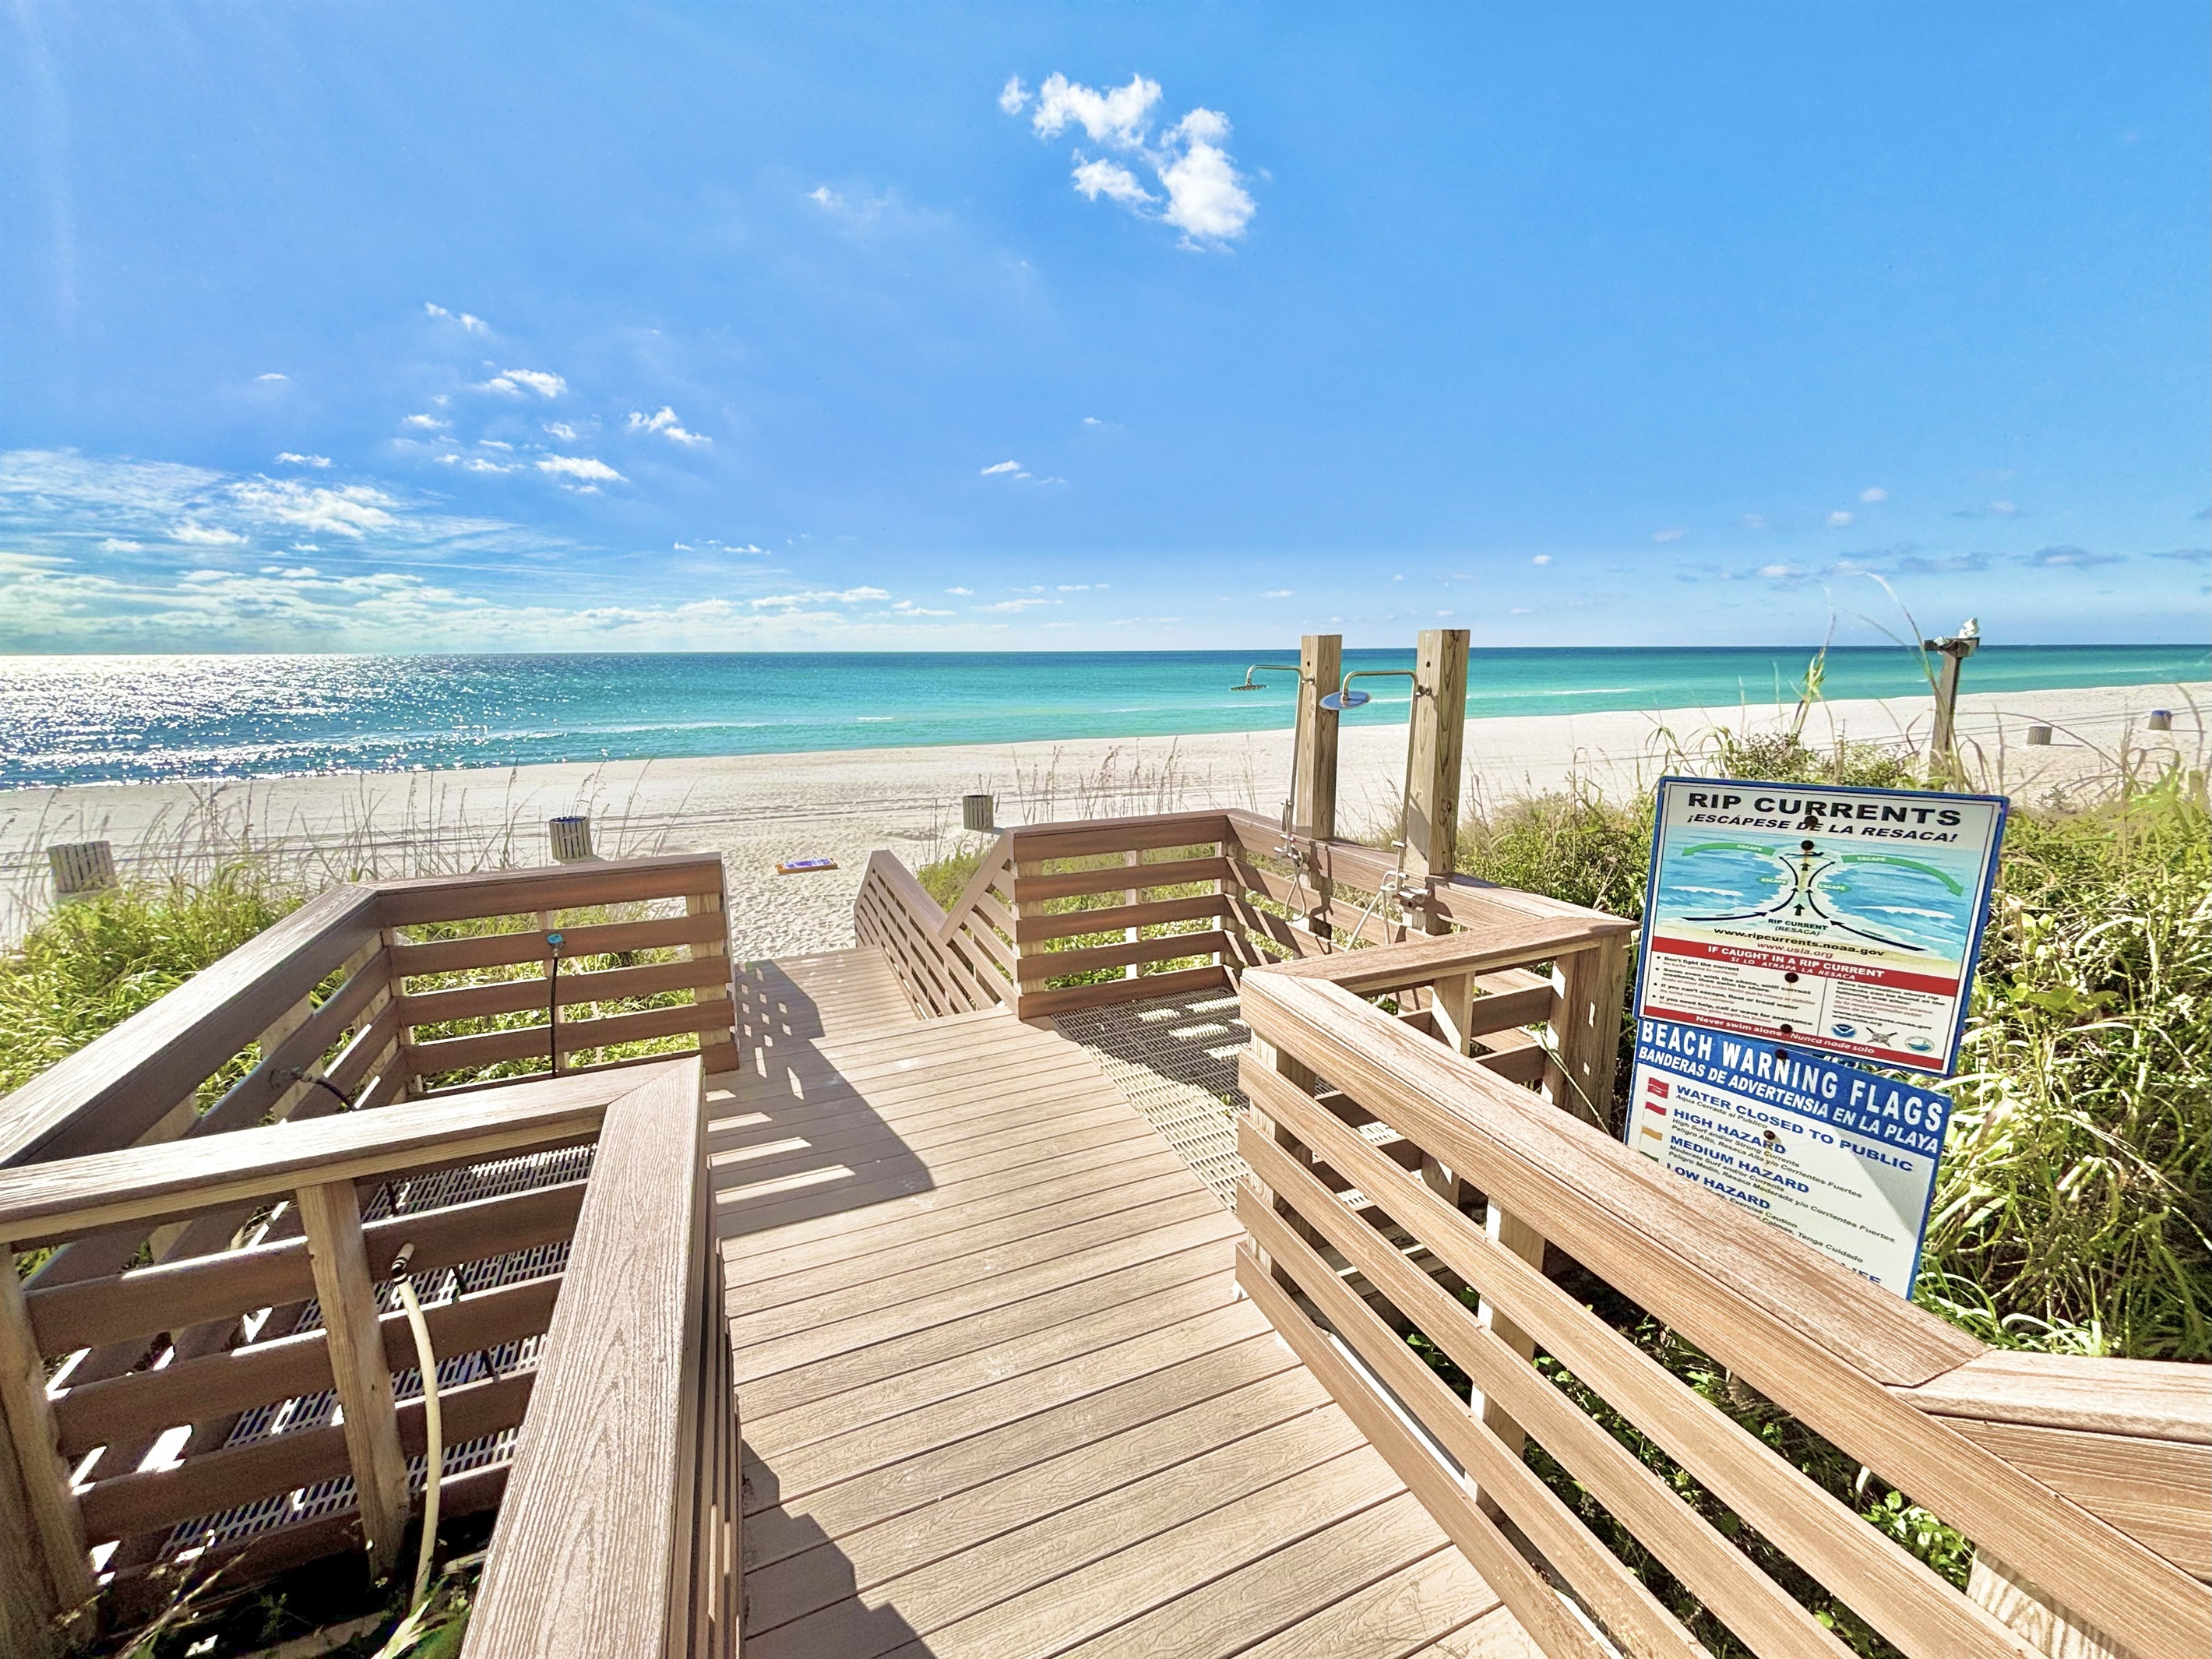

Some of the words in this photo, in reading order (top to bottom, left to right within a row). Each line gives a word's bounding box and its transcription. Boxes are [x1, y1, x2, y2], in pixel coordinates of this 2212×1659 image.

[1689, 793, 1741, 808] RIP
[1755, 798, 1960, 825] CURRENTS
[1687, 813, 1790, 829] ¡ESCÁPESE
[1795, 821, 1823, 832] DE
[1828, 824, 1853, 833] LA
[1862, 827, 1957, 842] RESACA!
[1775, 925, 1819, 936] (RESACA)
[1784, 921, 1827, 930] CURRENT
[1714, 929, 1883, 955] www.ripcurrents.noaa.gov
[1757, 943, 1833, 959] www.usla.org
[1721, 948, 1768, 960] CAUGHT
[1799, 959, 1819, 967] RIP
[1823, 963, 1884, 977] CURRENT
[1761, 961, 1796, 970] ATRAPA
[1818, 970, 1854, 980] RESACA
[1696, 1016, 1728, 1026] Never
[1753, 1027, 1782, 1036] alone
[1790, 1033, 1823, 1044] Nunca
[1823, 1041, 1851, 1049] nade
[1772, 1016, 1812, 1025] assistance
[1642, 1021, 1711, 1059] BEACH
[1722, 1041, 1838, 1099] WARNING
[1850, 1080, 1942, 1130] FLAGS
[1639, 1046, 1705, 1076] BANDERAS
[1707, 1067, 1727, 1084] DE
[1728, 1075, 1827, 1116] ADVERTENSIA
[1832, 1107, 1856, 1125] EN
[1858, 1115, 1879, 1134] LA
[1884, 1124, 1937, 1153] PLAYA
[1696, 1101, 1726, 1115] Cerrada
[1737, 1115, 1767, 1129] Publico
[1672, 1118, 1689, 1127] High
[1691, 1125, 1707, 1133] Surf
[1708, 1132, 1733, 1143] and/or
[1735, 1140, 1761, 1154] Strong
[1763, 1151, 1799, 1167] Currents
[1674, 1108, 1712, 1129] HIGH
[1717, 1123, 1786, 1154] HAZARD
[1677, 1085, 1731, 1109] WATER
[1736, 1105, 1803, 1133] CLOSED
[1809, 1129, 1833, 1143] TO
[1840, 1139, 1914, 1172] PUBLIC
[1669, 1144, 1703, 1161] Moderate
[1704, 1157, 1721, 1167] Surf
[1722, 1165, 1747, 1177] and/or
[1749, 1175, 1784, 1192] Currents
[1671, 1124, 1697, 1136] Peligro
[1698, 1134, 1715, 1144] Alto,
[1717, 1141, 1746, 1155] Resaca
[1747, 1153, 1764, 1161] Alta
[1765, 1157, 1778, 1168] y/o
[1781, 1164, 1825, 1184] Corrientes
[1827, 1182, 1862, 1198] Fuertes
[1671, 1136, 1733, 1164] MEDIUM
[1738, 1161, 1809, 1192] HAZARD
[1668, 1150, 1694, 1164] Peligro
[1695, 1161, 1720, 1175] Medio,
[1721, 1171, 1751, 1185] Resaca
[1752, 1183, 1793, 1202] Moderada
[1810, 1206, 1857, 1227] Corrientes
[1703, 1177, 1770, 1209] HAZARD
[1765, 1212, 1798, 1228] Caution
[1798, 1231, 1823, 1246] Tenga
[1825, 1244, 1864, 1263] Cuidado
